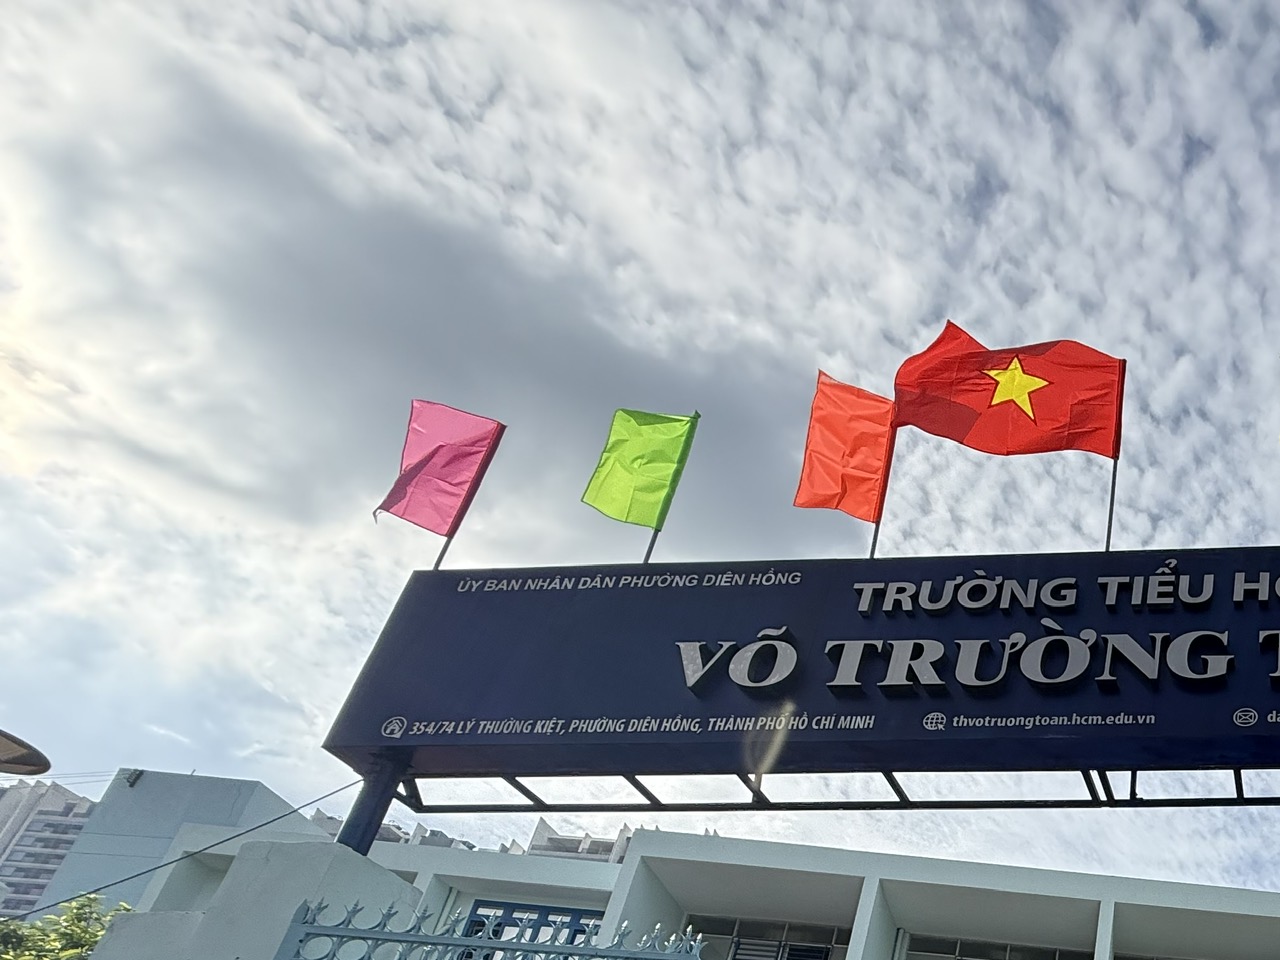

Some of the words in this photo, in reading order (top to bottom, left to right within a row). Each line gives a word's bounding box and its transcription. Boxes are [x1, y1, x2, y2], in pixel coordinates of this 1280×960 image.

[457, 576, 483, 592] ỦY
[483, 578, 523, 591] BAN
[524, 575, 575, 590] NHÂN
[577, 574, 615, 589] DÂN
[618, 572, 699, 588] PHƯỜNG
[702, 571, 745, 587] DIÊN
[748, 567, 802, 586] HỒNG
[853, 569, 1077, 611] TRƯỜNG
[1097, 558, 1215, 606] TIỂU
[675, 625, 798, 688] VÕ
[824, 617, 1235, 686] TRƯỜNG
[408, 720, 454, 735] 354/74
[456, 718, 477, 734] LÝ
[477, 717, 533, 734] THƯỜNG
[533, 717, 566, 736] KIỆT,
[568, 716, 625, 733] PHƯỜNG
[627, 716, 660, 732] DIÊN
[660, 714, 703, 734] HỒNG,
[707, 714, 753, 731] THÀNH
[756, 712, 790, 730] PHỐ
[788, 711, 808, 730] HỒ
[811, 714, 836, 730] CHÍ
[837, 715, 875, 730] MINH
[952, 712, 1156, 729] thvotruongtoan.hcm.edu.vn
